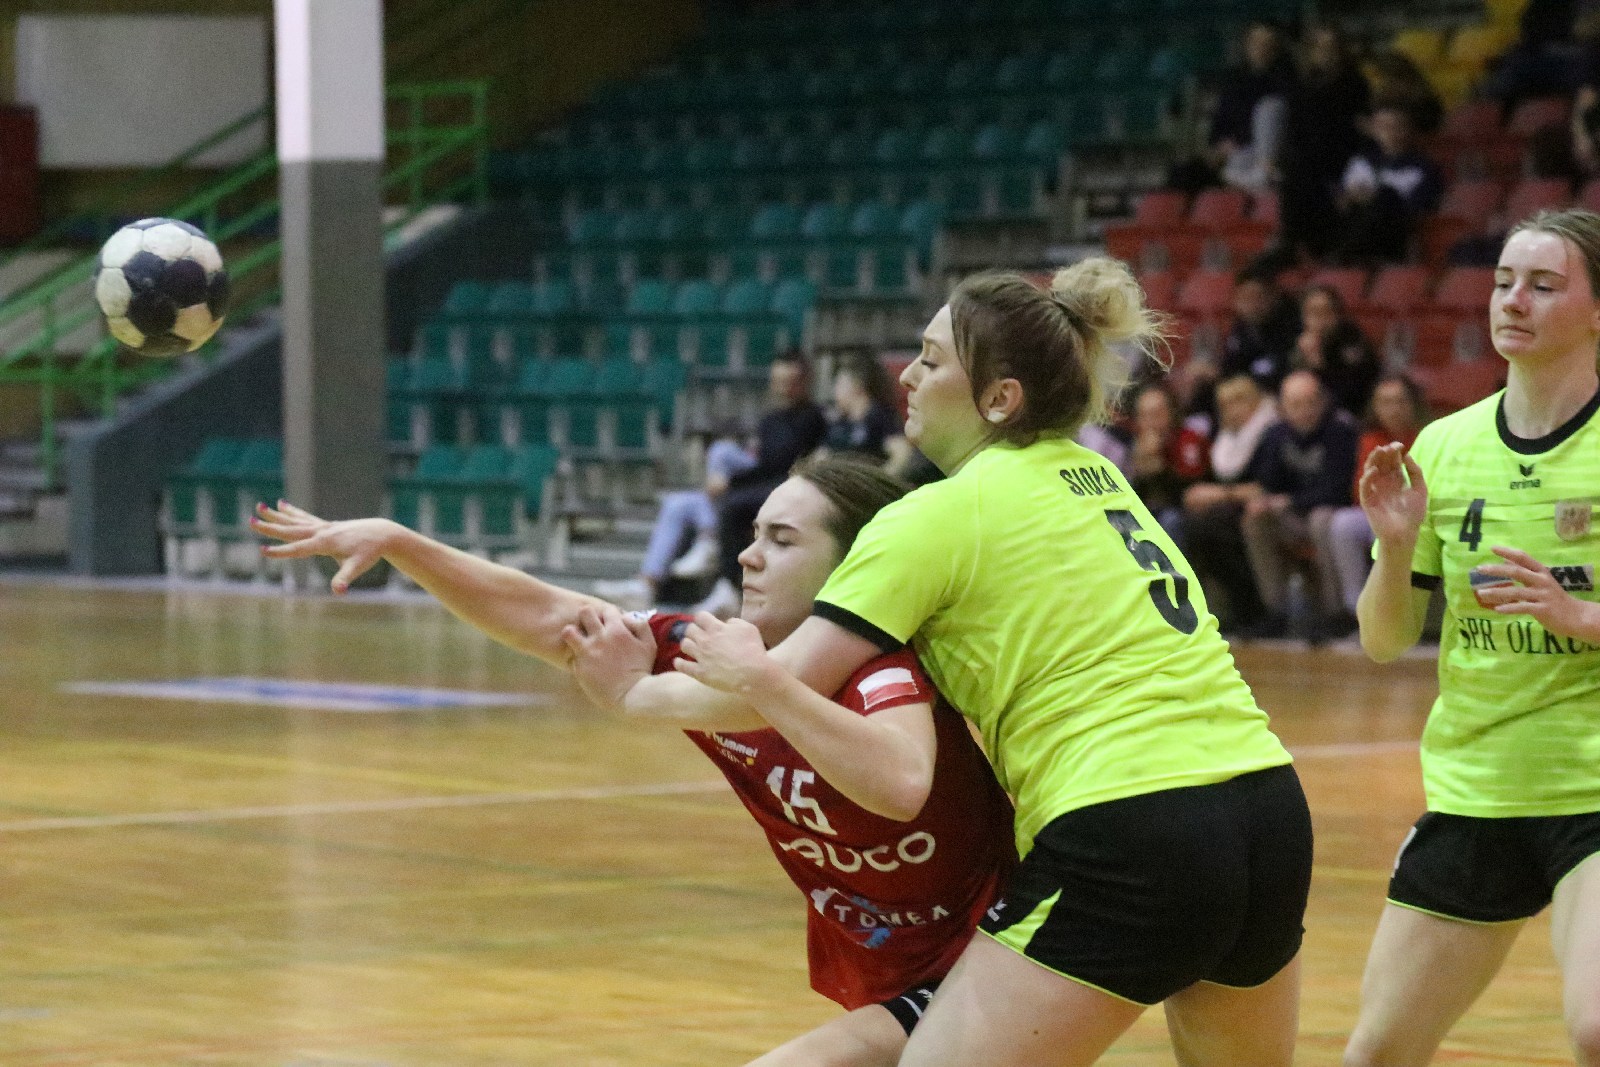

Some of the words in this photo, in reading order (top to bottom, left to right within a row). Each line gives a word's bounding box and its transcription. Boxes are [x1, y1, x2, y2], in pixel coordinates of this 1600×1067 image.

[1509, 478, 1541, 490] erima
[1459, 498, 1486, 552] 4
[1103, 508, 1199, 636] 5
[1458, 617, 1497, 651] SPR
[765, 765, 838, 836] 15
